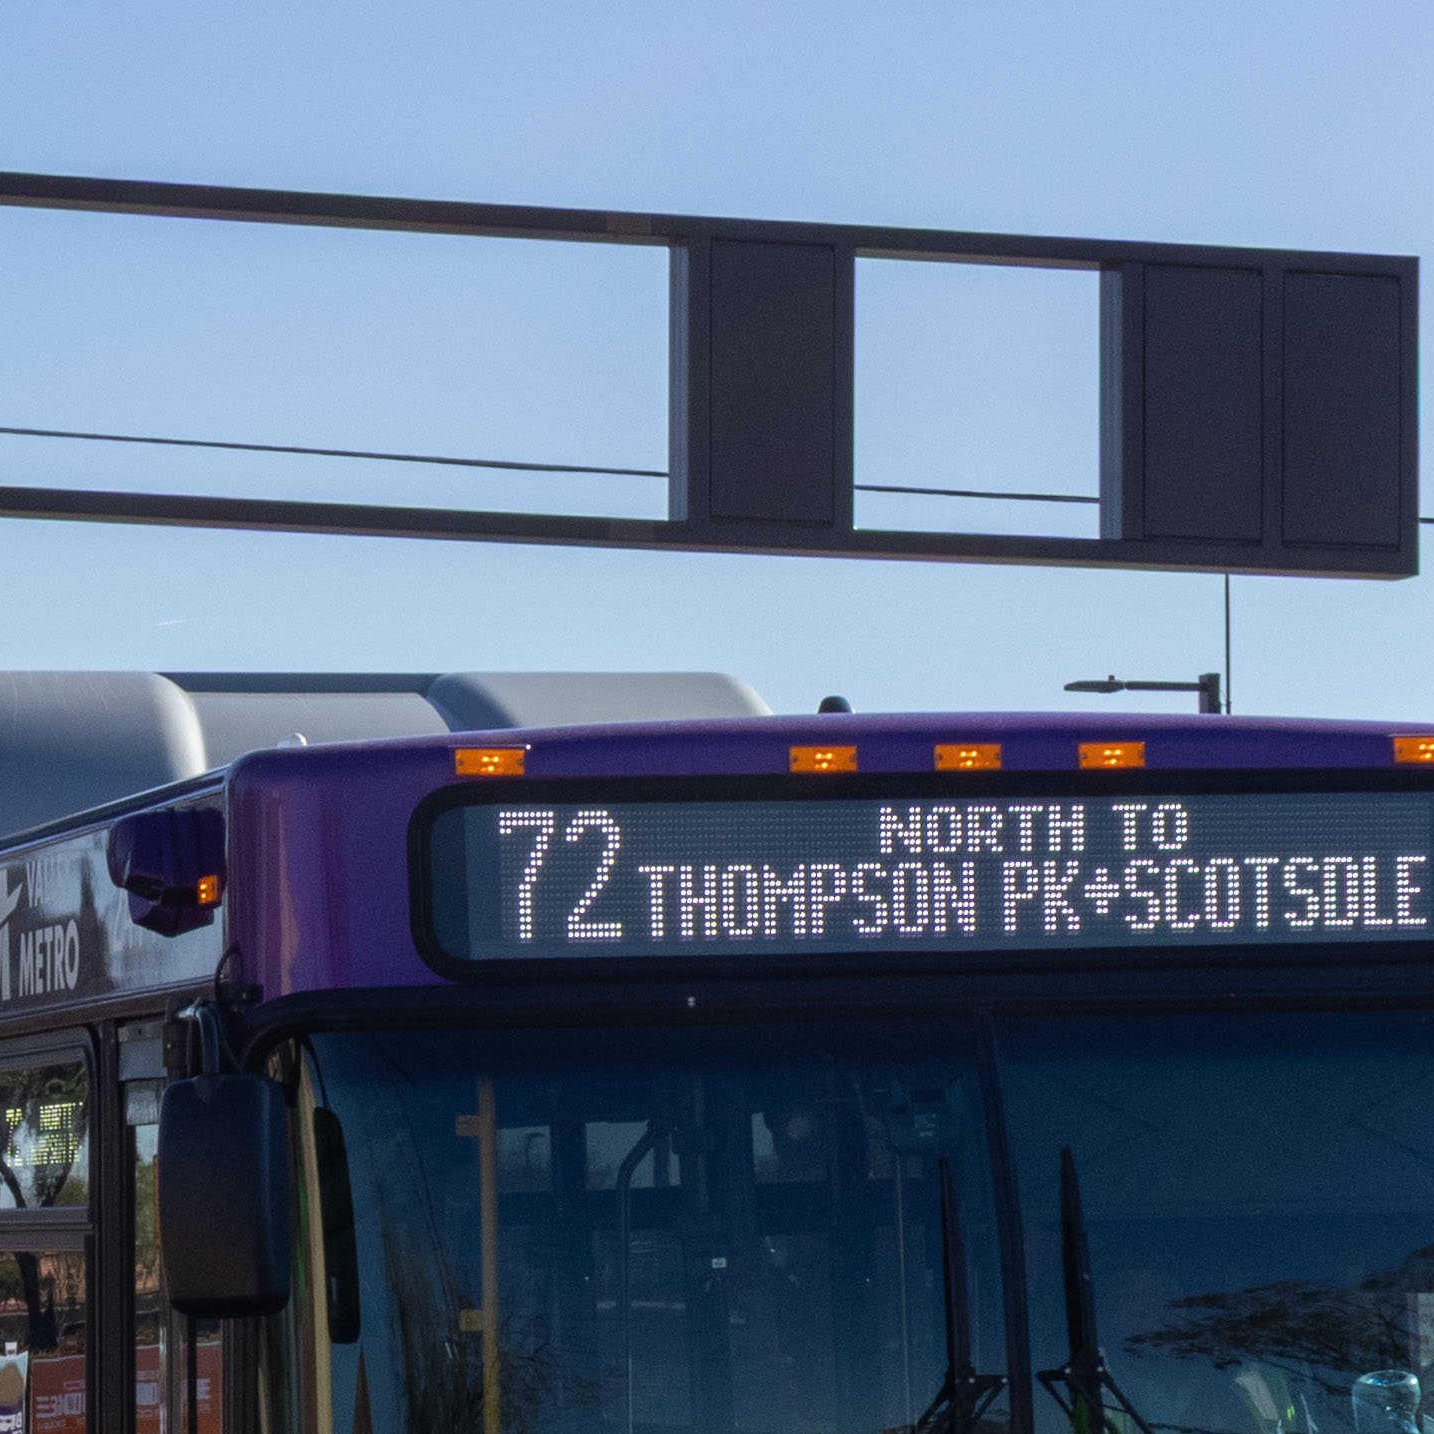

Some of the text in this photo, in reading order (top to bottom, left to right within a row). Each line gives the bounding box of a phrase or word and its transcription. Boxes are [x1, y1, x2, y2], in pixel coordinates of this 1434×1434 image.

[879, 803, 1188, 854] NORTH TO
[498, 809, 623, 941] 72
[637, 861, 977, 938] THOMPSON
[19, 919, 79, 997] METRO
